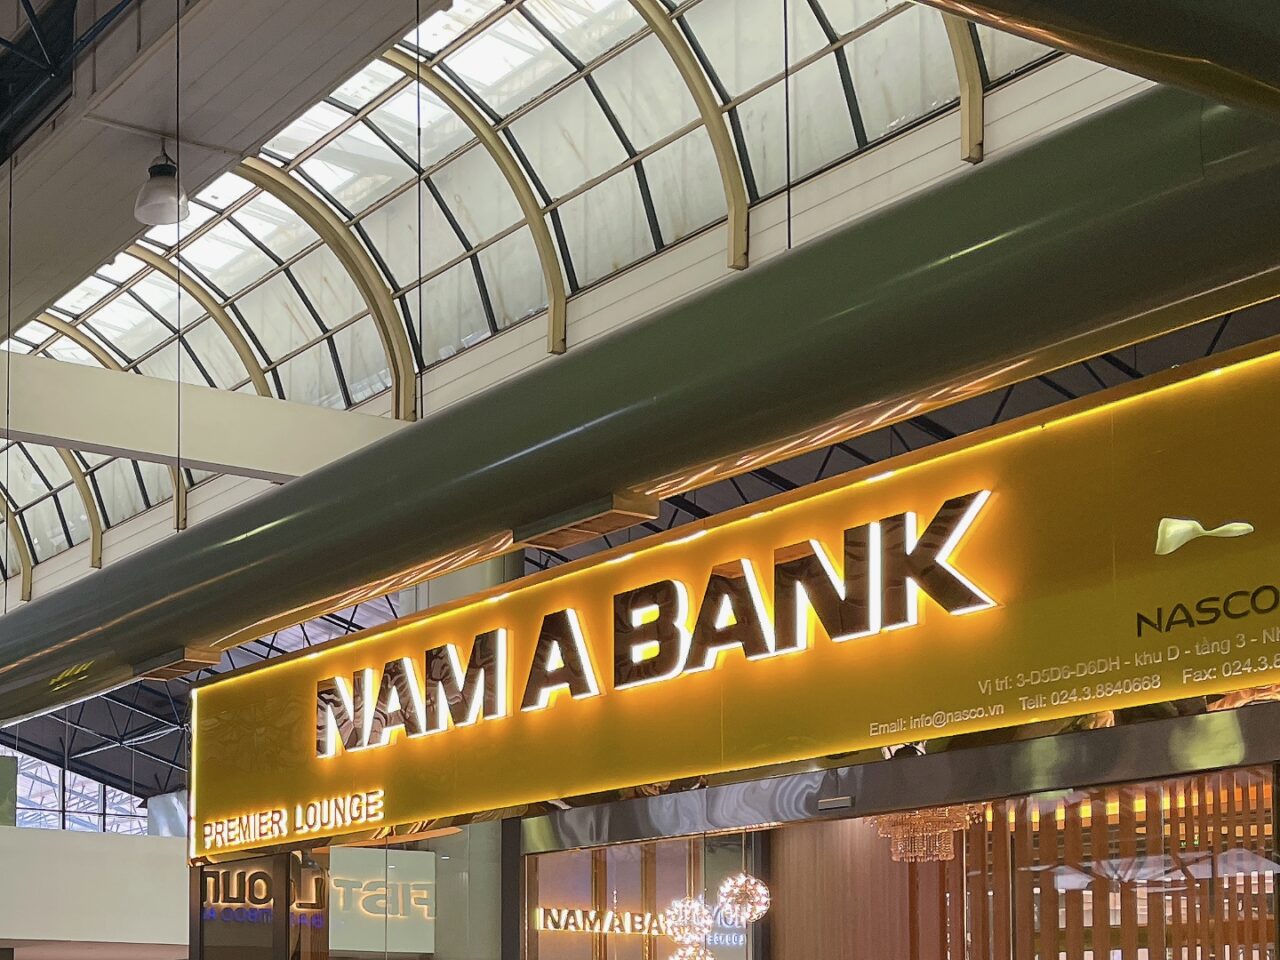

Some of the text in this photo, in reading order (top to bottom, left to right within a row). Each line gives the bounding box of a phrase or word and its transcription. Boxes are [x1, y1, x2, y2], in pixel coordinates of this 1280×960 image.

[316, 489, 999, 760] NAM A BANK
[1136, 584, 1280, 638] NASCO
[1016, 656, 1120, 690] 3-D5D6-D6DH
[1135, 650, 1163, 676] khu
[1167, 645, 1180, 661] D
[1235, 633, 1246, 648] 3
[869, 717, 907, 737] Email:
[909, 703, 1005, 730] info@nasco.vn
[1050, 674, 1162, 707] 024.3.8840668
[1182, 667, 1217, 684] Fax:
[202, 788, 385, 850] PREMIER LOUNGE
